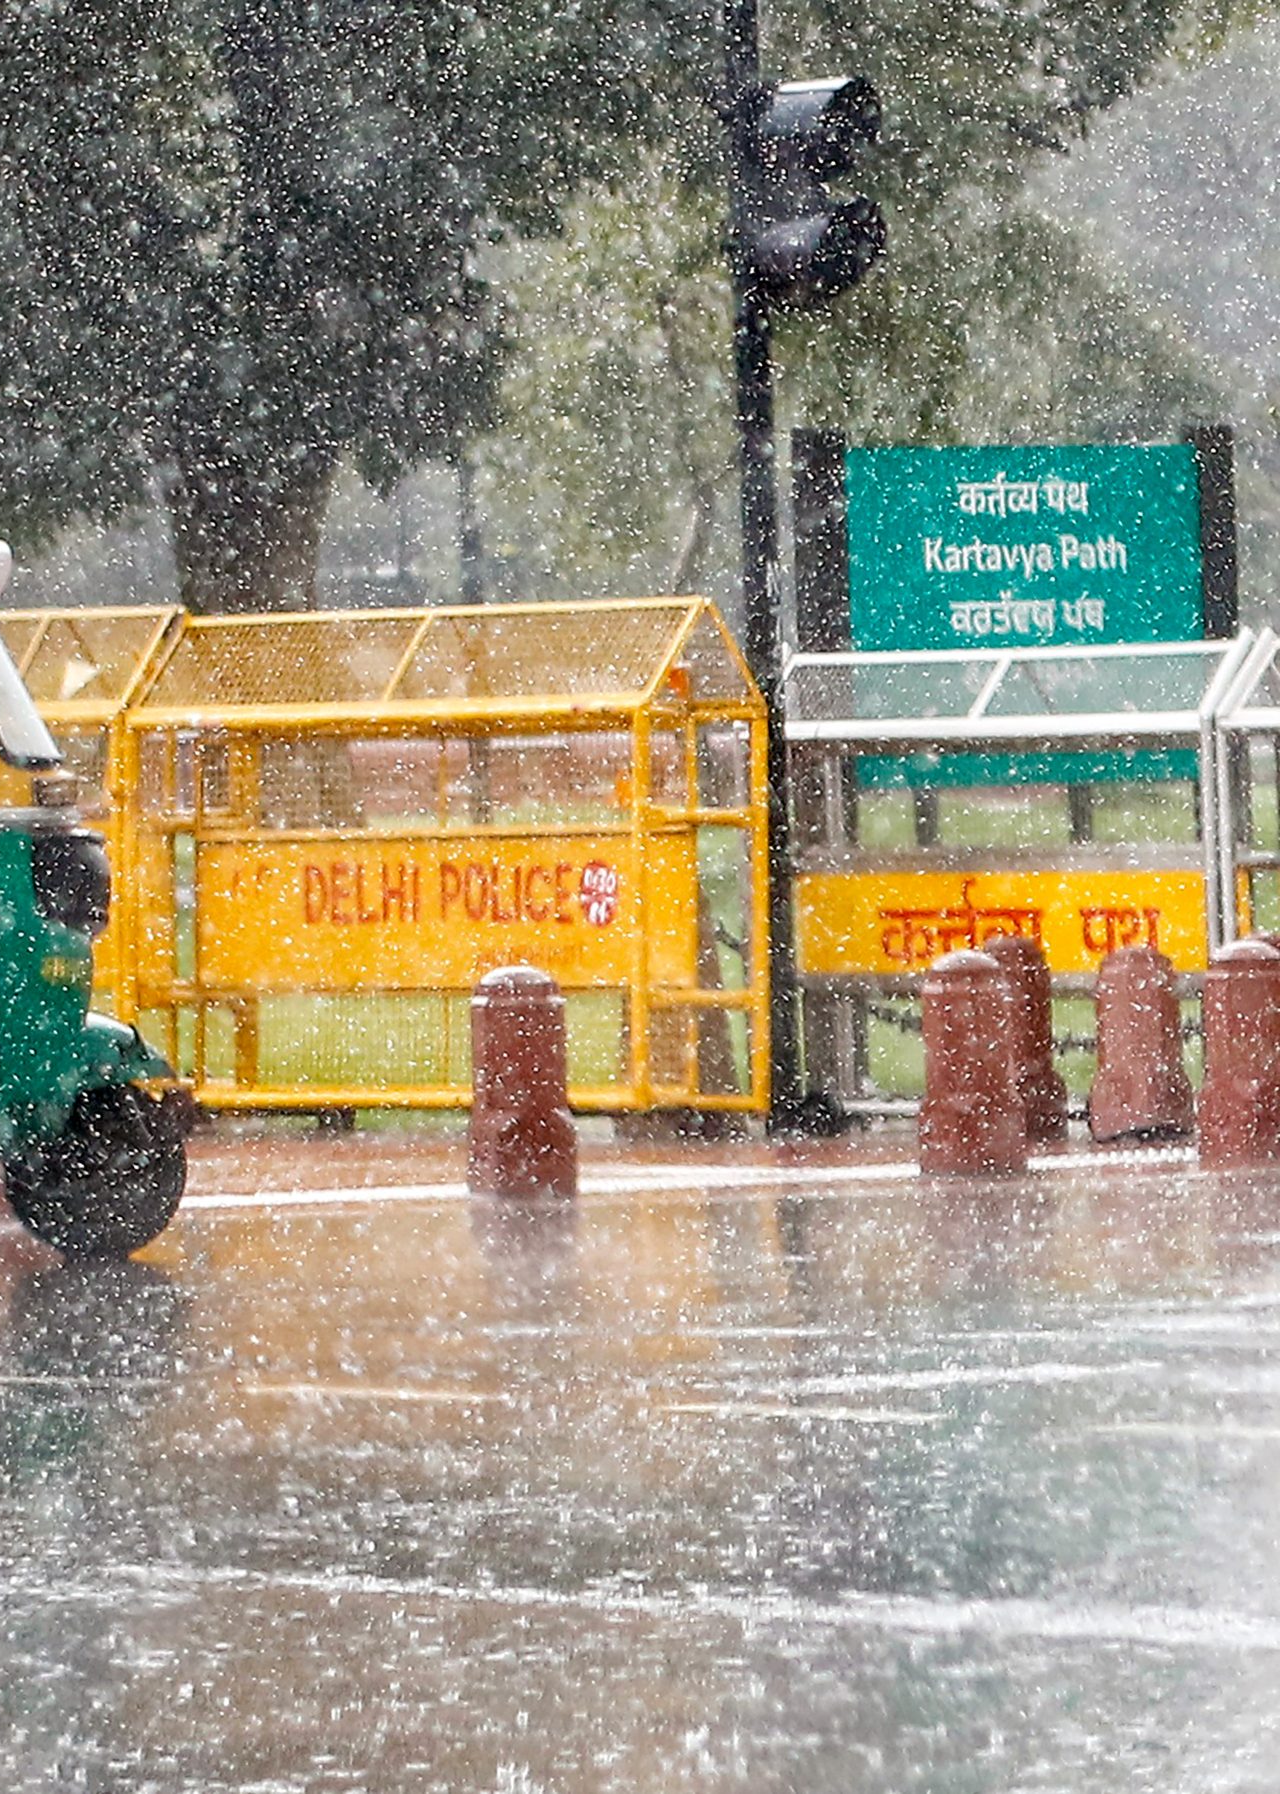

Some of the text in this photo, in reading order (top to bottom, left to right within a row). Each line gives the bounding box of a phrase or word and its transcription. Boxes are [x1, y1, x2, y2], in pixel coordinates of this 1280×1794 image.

[1041, 480, 1090, 517] पथ
[923, 533, 1128, 580] Kartavya Path
[303, 861, 420, 926] DELHI
[439, 860, 575, 927] POLICE
